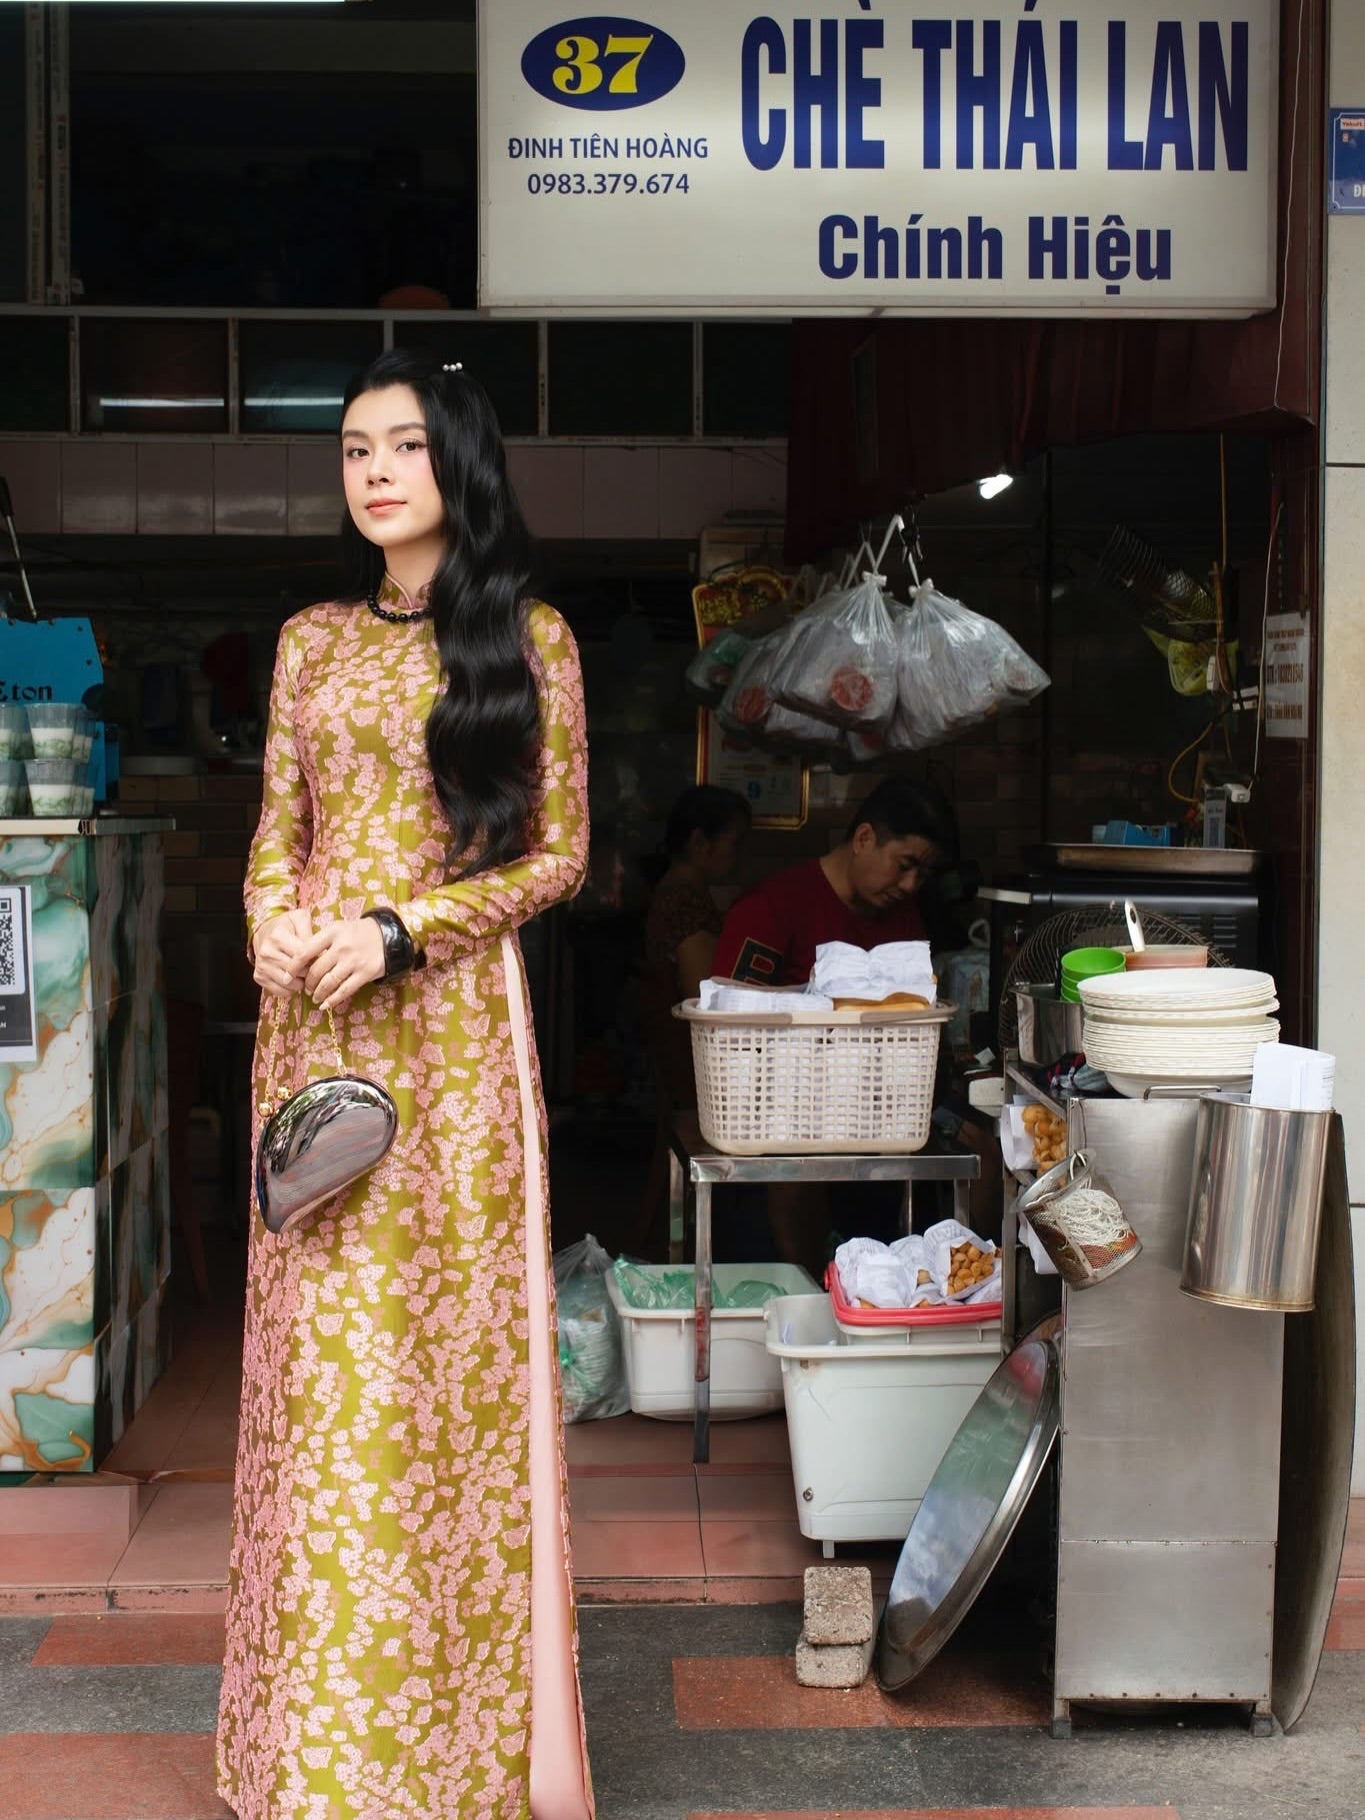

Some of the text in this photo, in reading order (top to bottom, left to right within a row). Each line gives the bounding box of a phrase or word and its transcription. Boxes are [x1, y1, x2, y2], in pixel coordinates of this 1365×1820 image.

[552, 34, 654, 94] 37
[741, 0, 1249, 171] CHÈ THÁI LAN
[508, 130, 709, 160] ĐINH TIÊN HOÀNG
[527, 174, 690, 195] 0983.379.674
[818, 214, 1172, 295] Chính Hiệu
